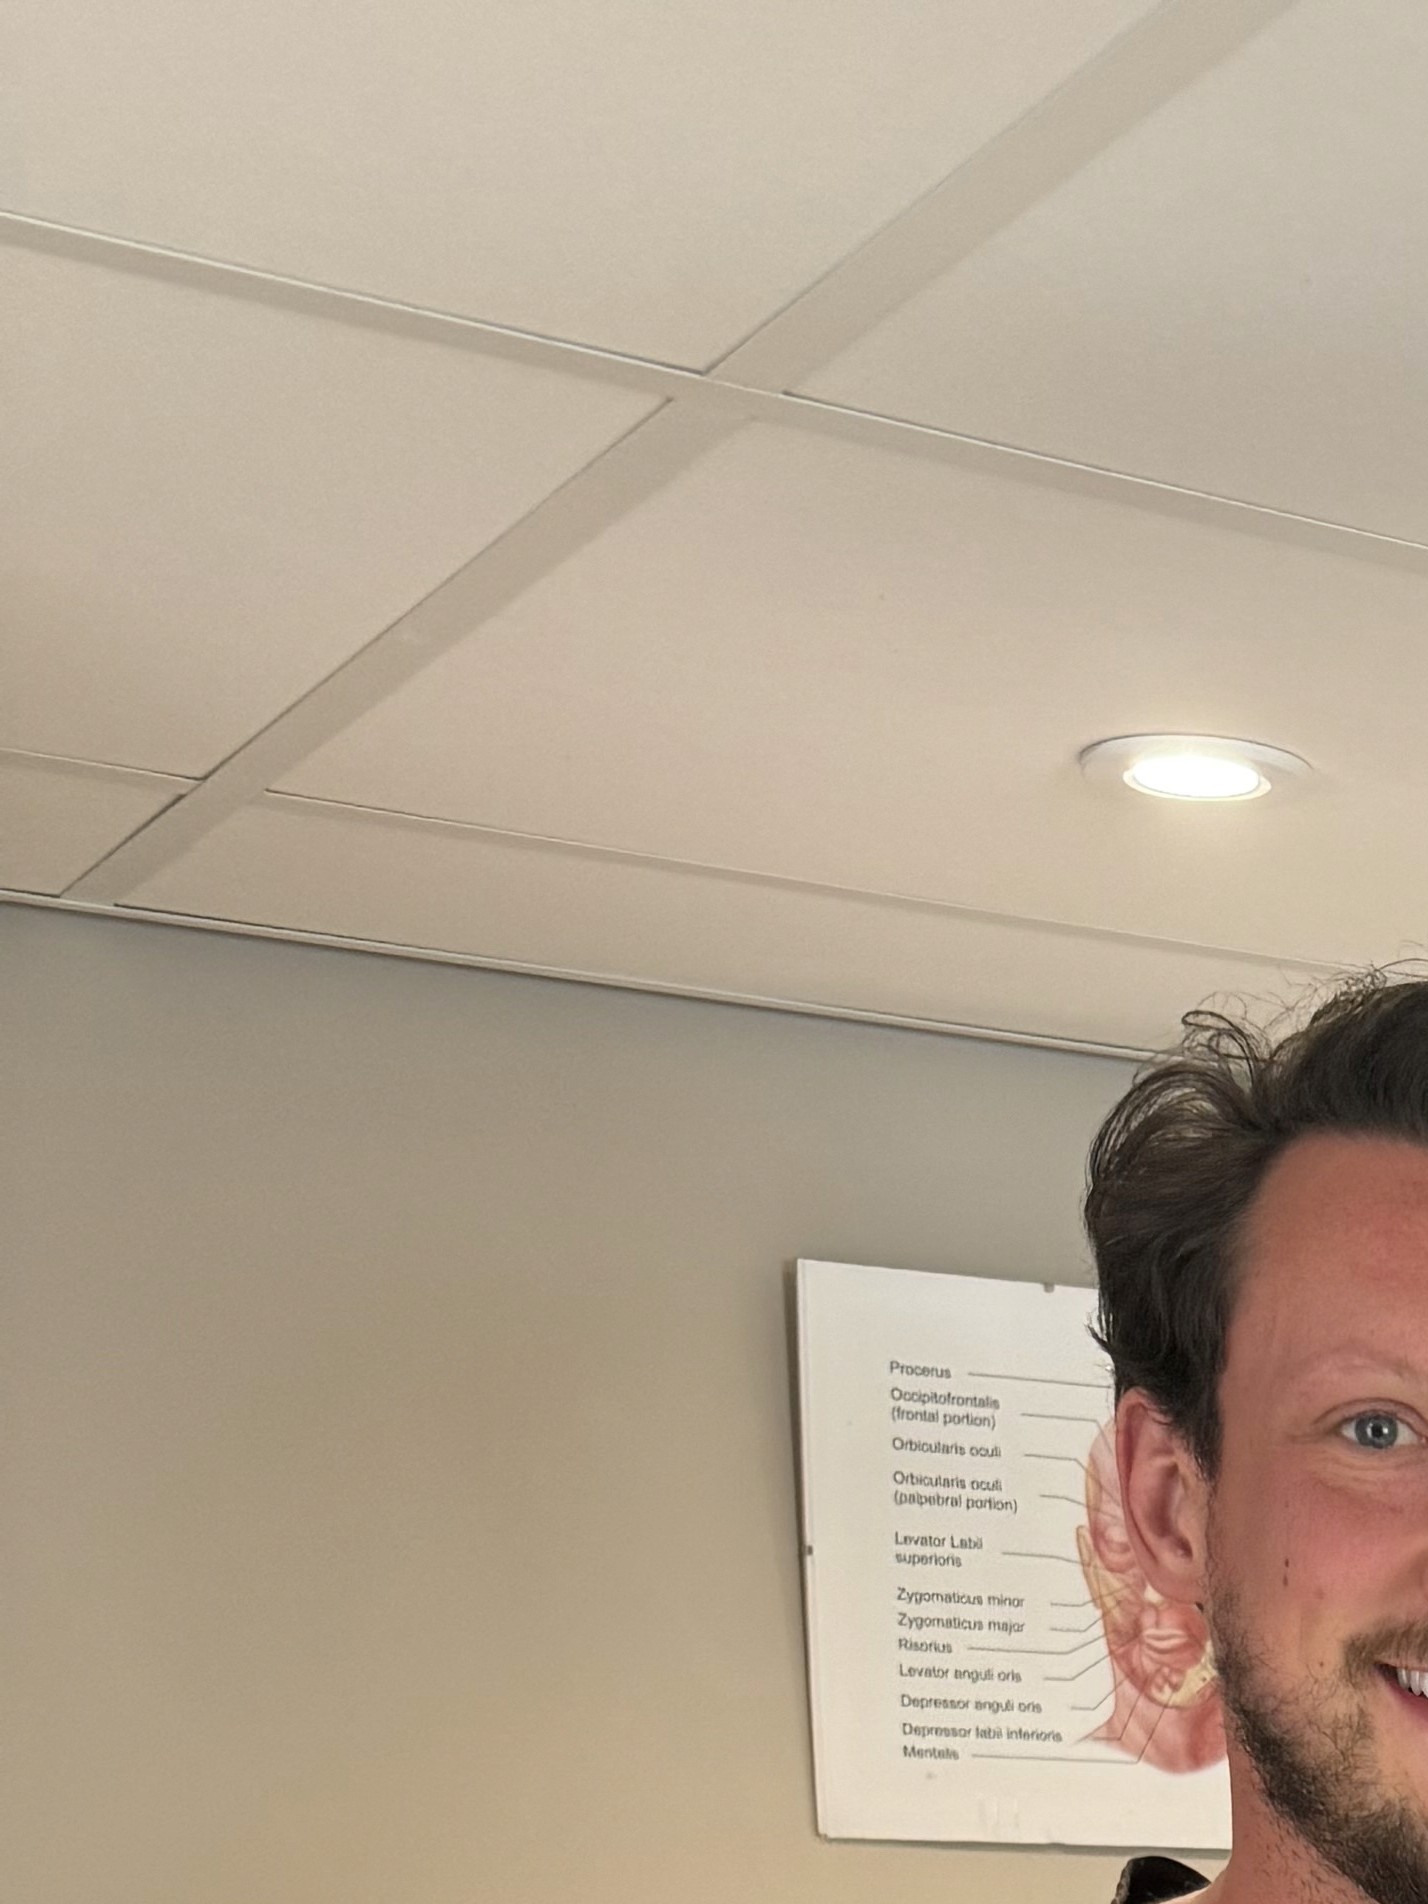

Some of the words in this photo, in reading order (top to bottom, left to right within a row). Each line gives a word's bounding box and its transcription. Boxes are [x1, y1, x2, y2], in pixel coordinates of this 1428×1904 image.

[890, 1360, 951, 1379] Procerus
[891, 1387, 1000, 1410] Occipitofrontalis
[892, 1406, 939, 1423] (frontal
[943, 1412, 996, 1431] portion)
[892, 1437, 966, 1456] Orbicularis
[969, 1446, 1002, 1458] oculi
[893, 1470, 966, 1490] Orbicularis
[970, 1478, 1003, 1492] oculi
[966, 1497, 1018, 1514] portion)
[894, 1531, 946, 1548] Levator
[895, 1551, 962, 1568] superioris
[896, 1586, 984, 1606] Zygomaticus
[987, 1594, 1026, 1608] minor
[897, 1612, 984, 1631] Zygomaticus
[988, 1619, 1026, 1636] major
[898, 1638, 953, 1653] Risorius
[899, 1664, 949, 1679] Levator
[954, 1668, 995, 1683] anguli
[998, 1669, 1022, 1683] oris
[901, 1694, 970, 1710] Depressor
[974, 1700, 1014, 1713] anguli
[1018, 1701, 1042, 1713] oris
[902, 1722, 972, 1739] Depressor
[903, 1745, 960, 1760] Mentalis
